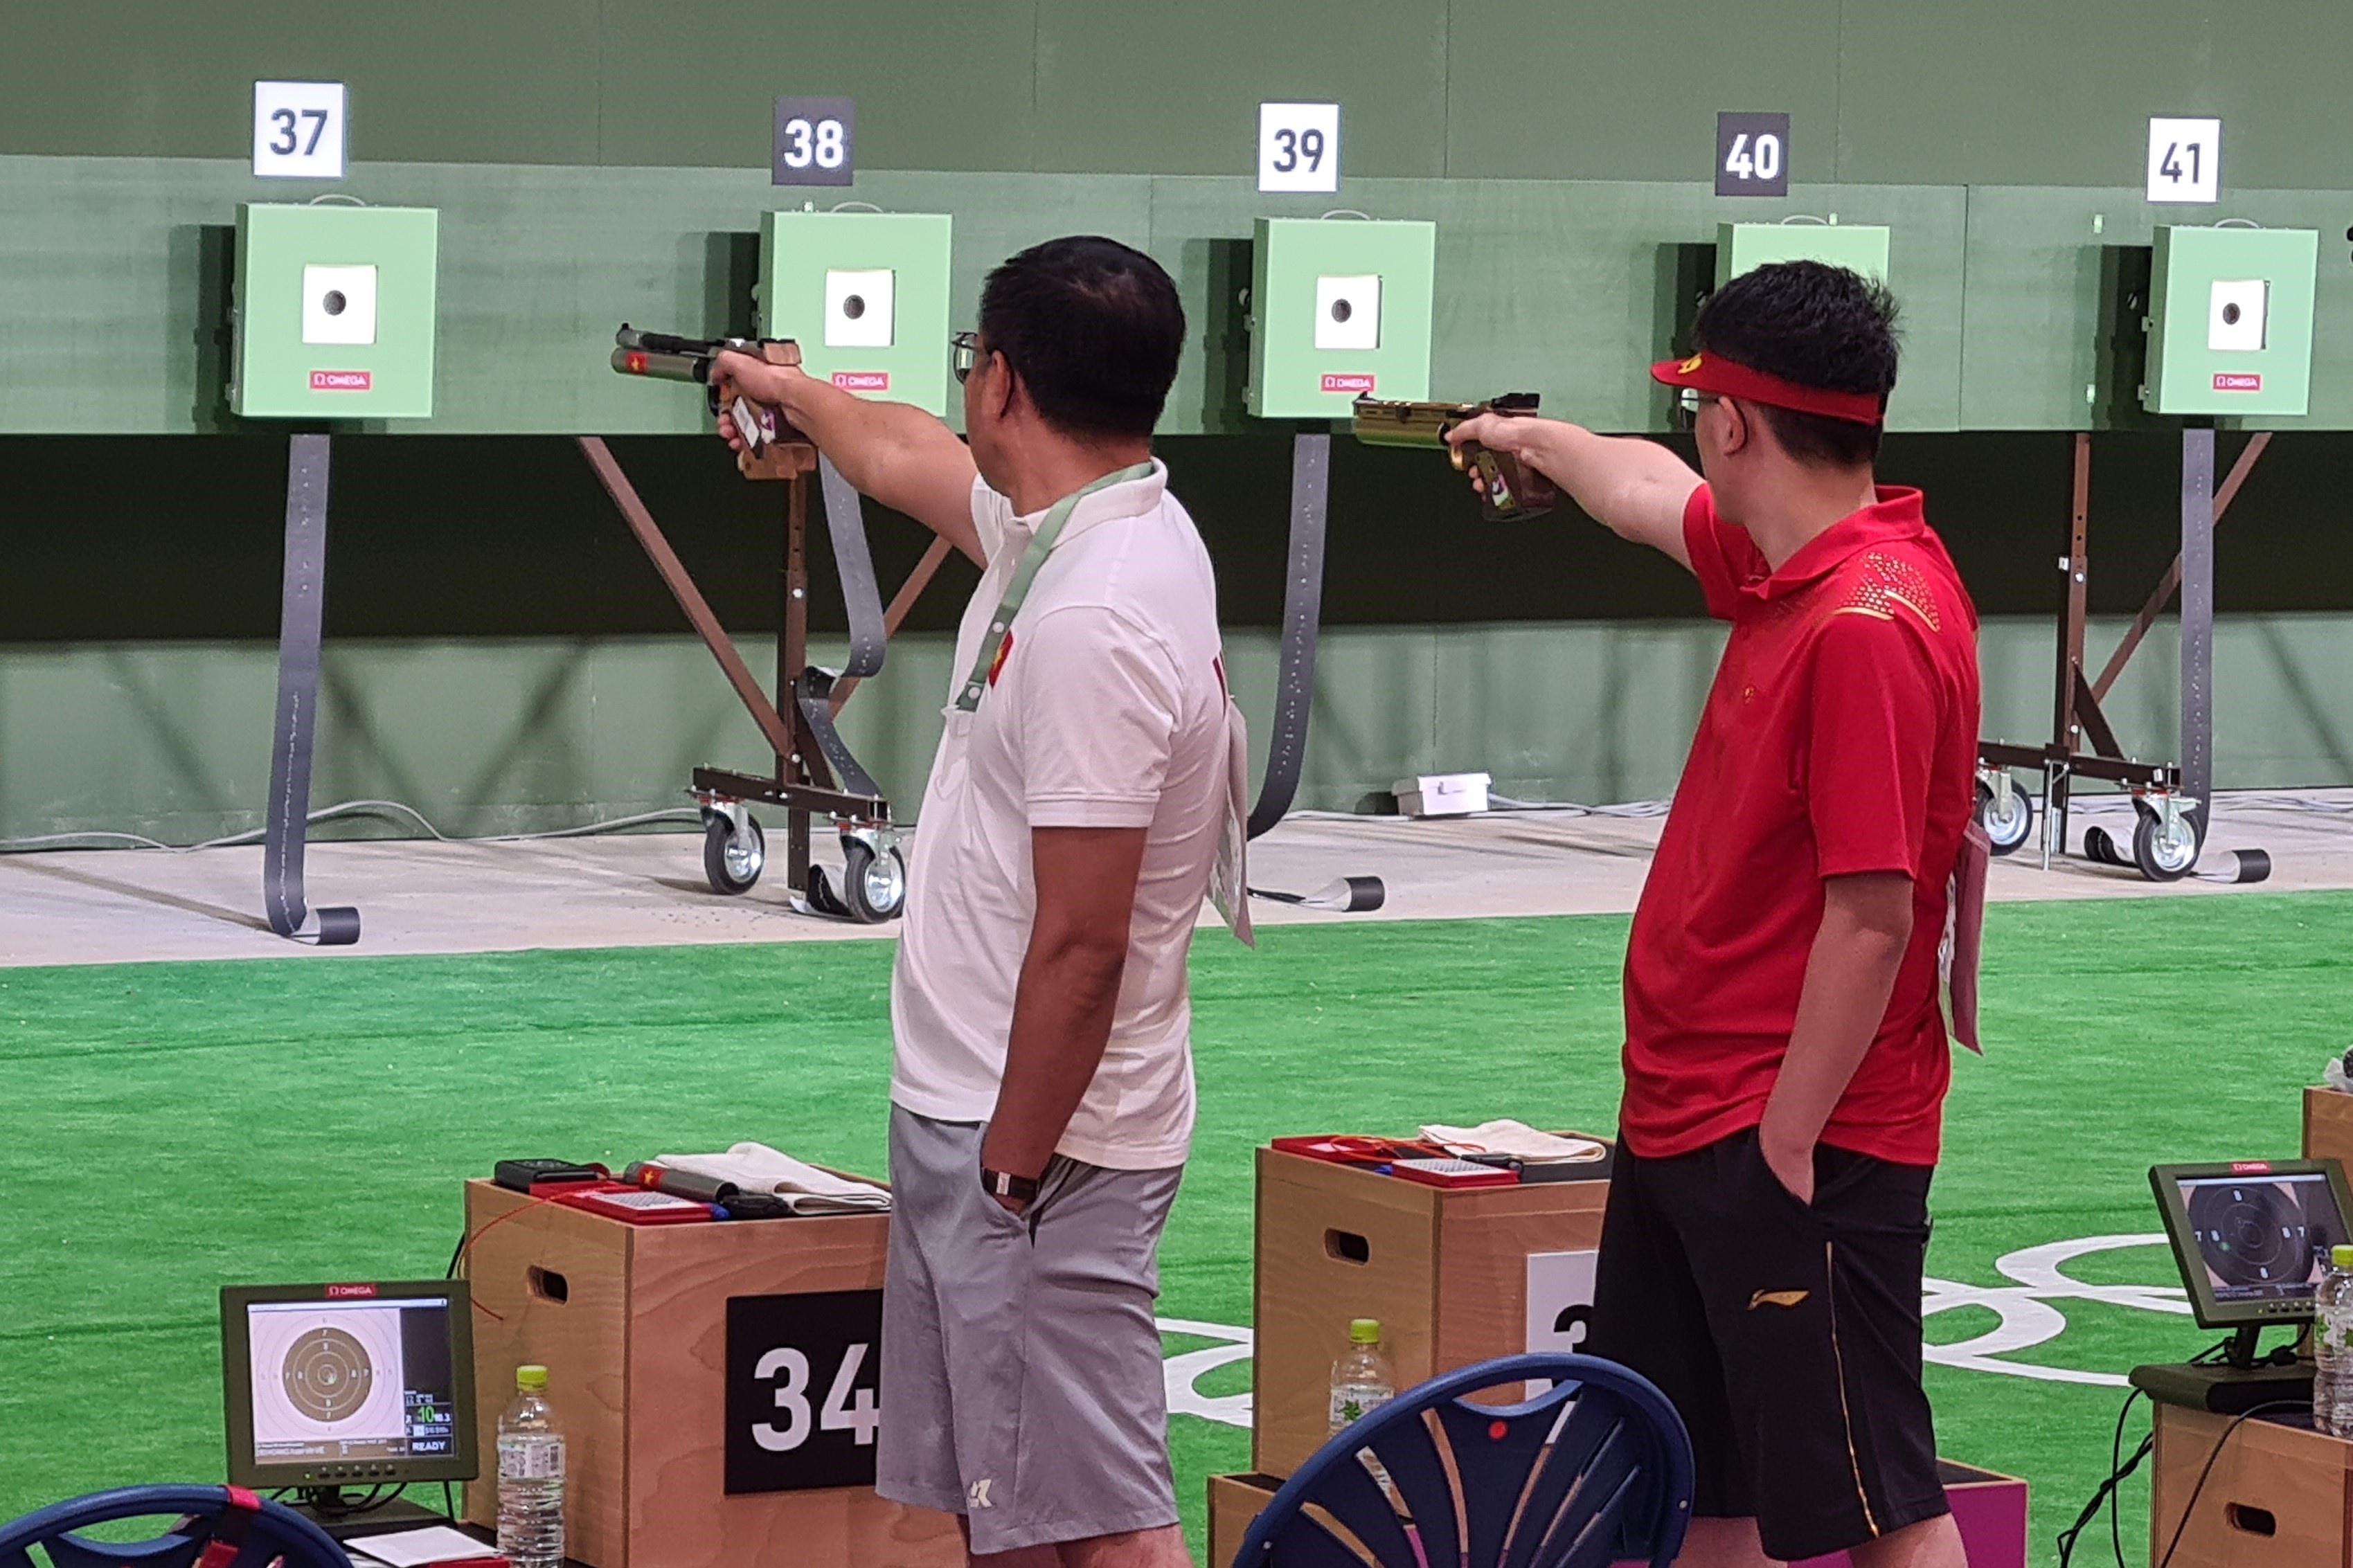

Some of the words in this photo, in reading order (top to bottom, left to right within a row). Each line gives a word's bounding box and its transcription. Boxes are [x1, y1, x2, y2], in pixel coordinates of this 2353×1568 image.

[269, 108, 328, 156] 37
[783, 118, 844, 168] 38
[1272, 128, 1325, 173] 39
[1725, 134, 1780, 180] 40
[2159, 142, 2201, 184] 41
[751, 1343, 879, 1452] 34
[412, 1441, 445, 1452] READY
